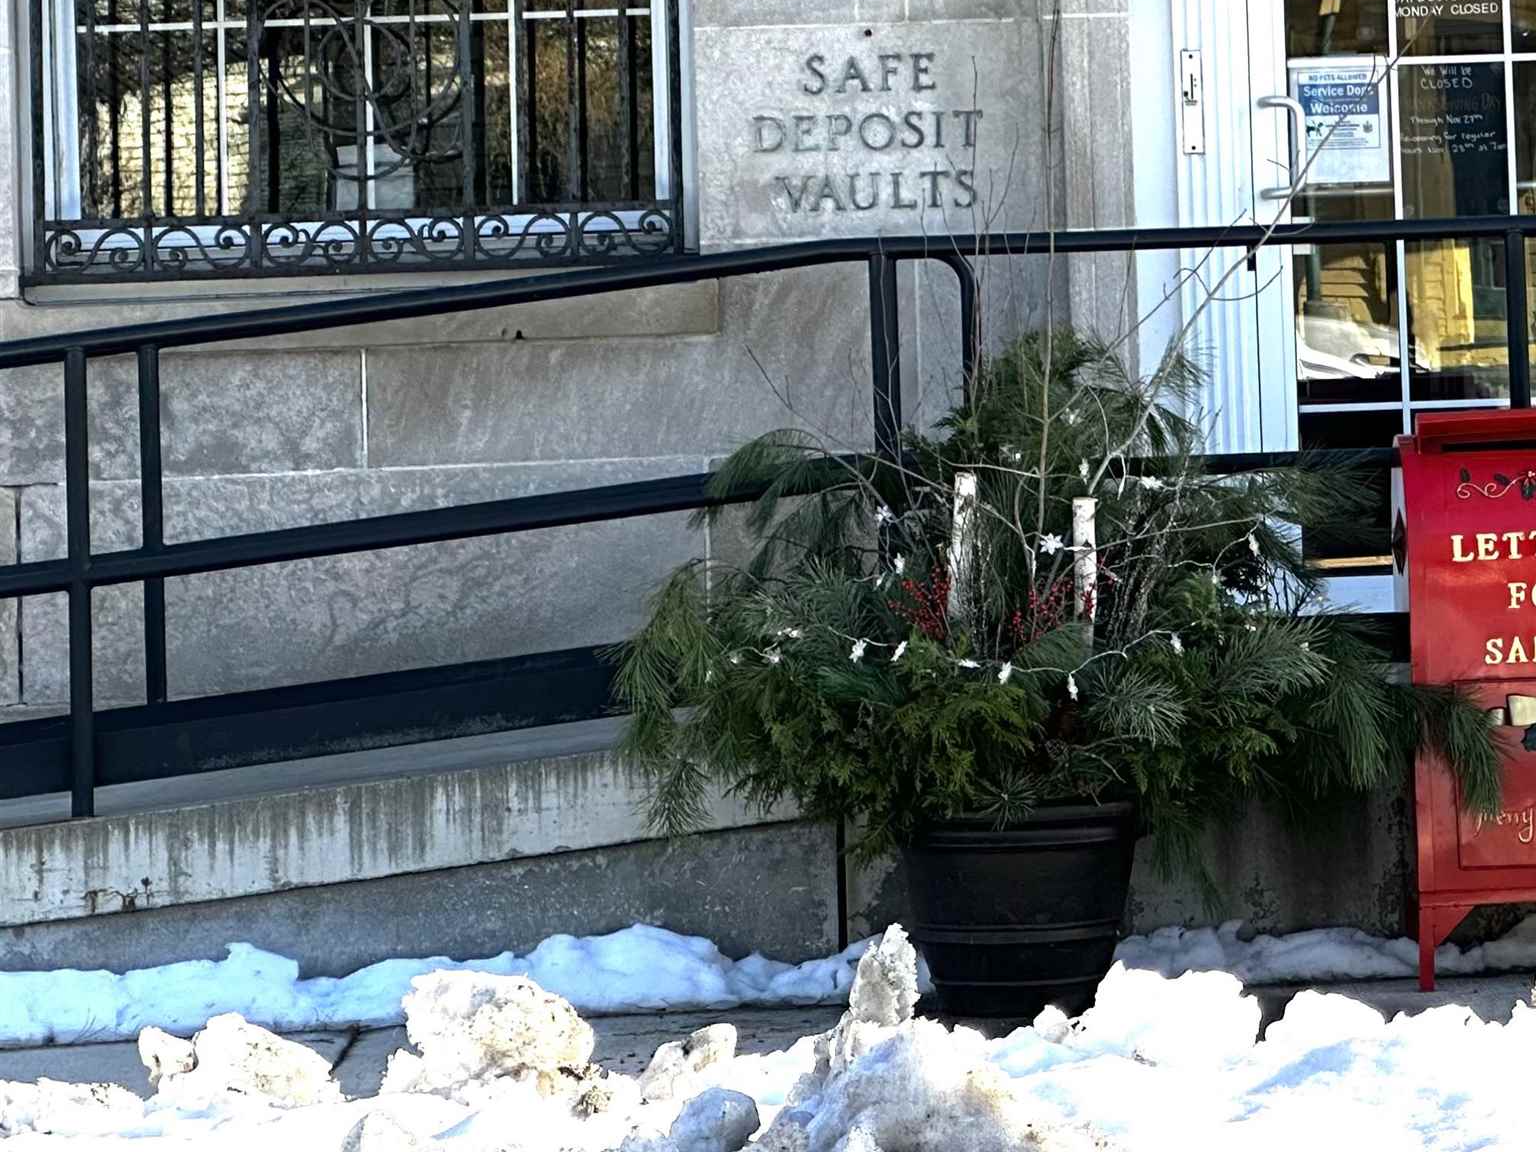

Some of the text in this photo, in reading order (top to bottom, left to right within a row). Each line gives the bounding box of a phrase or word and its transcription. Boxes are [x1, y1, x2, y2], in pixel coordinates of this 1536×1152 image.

[1450, 2, 1499, 15] CLOSED
[804, 52, 936, 96] SAFE
[1420, 76, 1473, 89] CLOSED
[1303, 85, 1345, 97] Service
[752, 109, 983, 153] DEPOSIT
[775, 170, 979, 213] VAULTS
